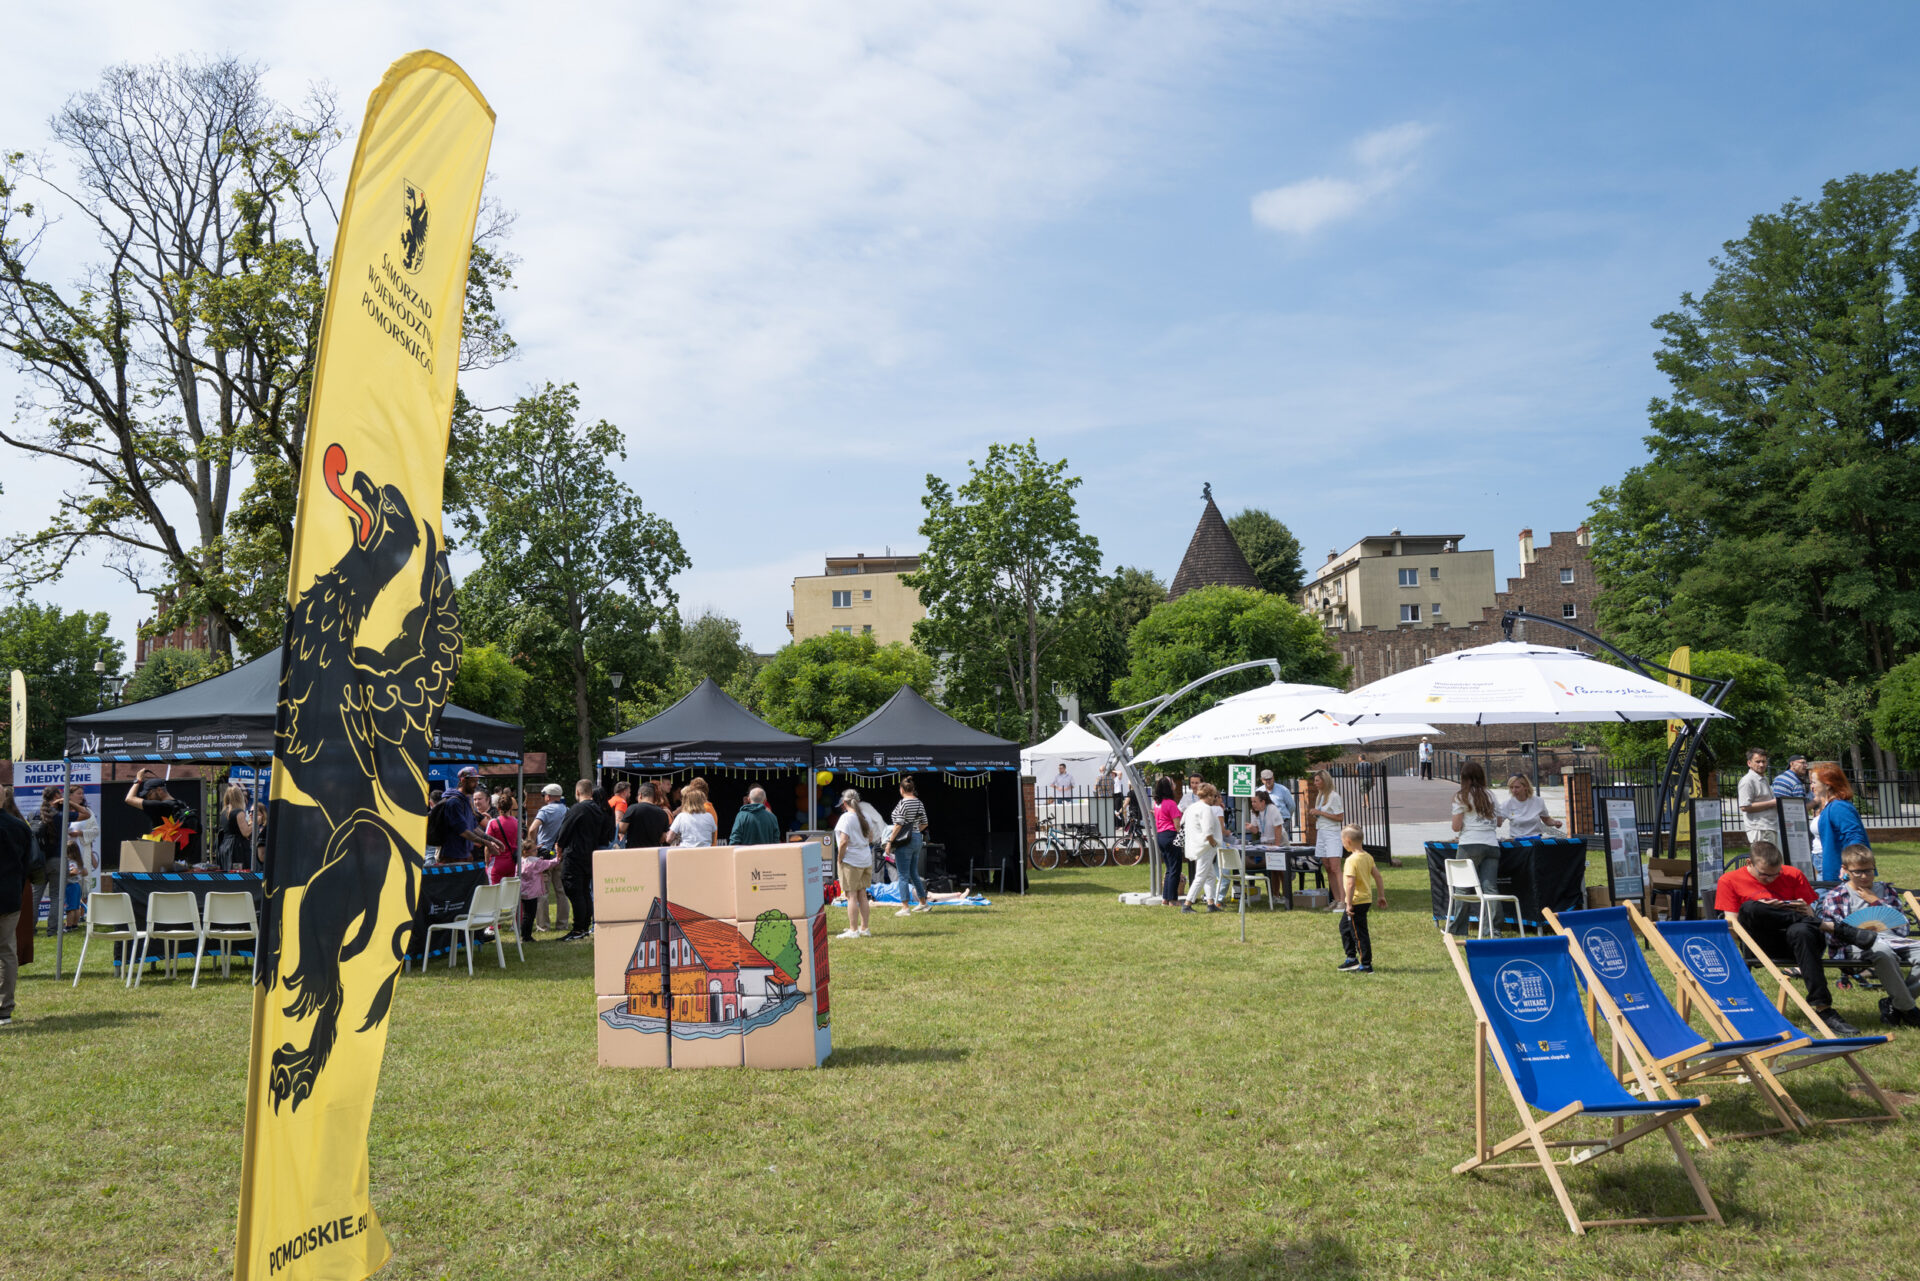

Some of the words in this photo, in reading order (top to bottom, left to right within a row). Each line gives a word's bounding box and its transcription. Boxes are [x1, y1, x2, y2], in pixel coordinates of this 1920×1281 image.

[362, 291, 432, 375] POMORSKIEGO
[25, 764, 66, 773] SKLEPY
[604, 886, 645, 894] ZAMKOWY
[270, 1213, 368, 1276] POMORSKIE.eu
